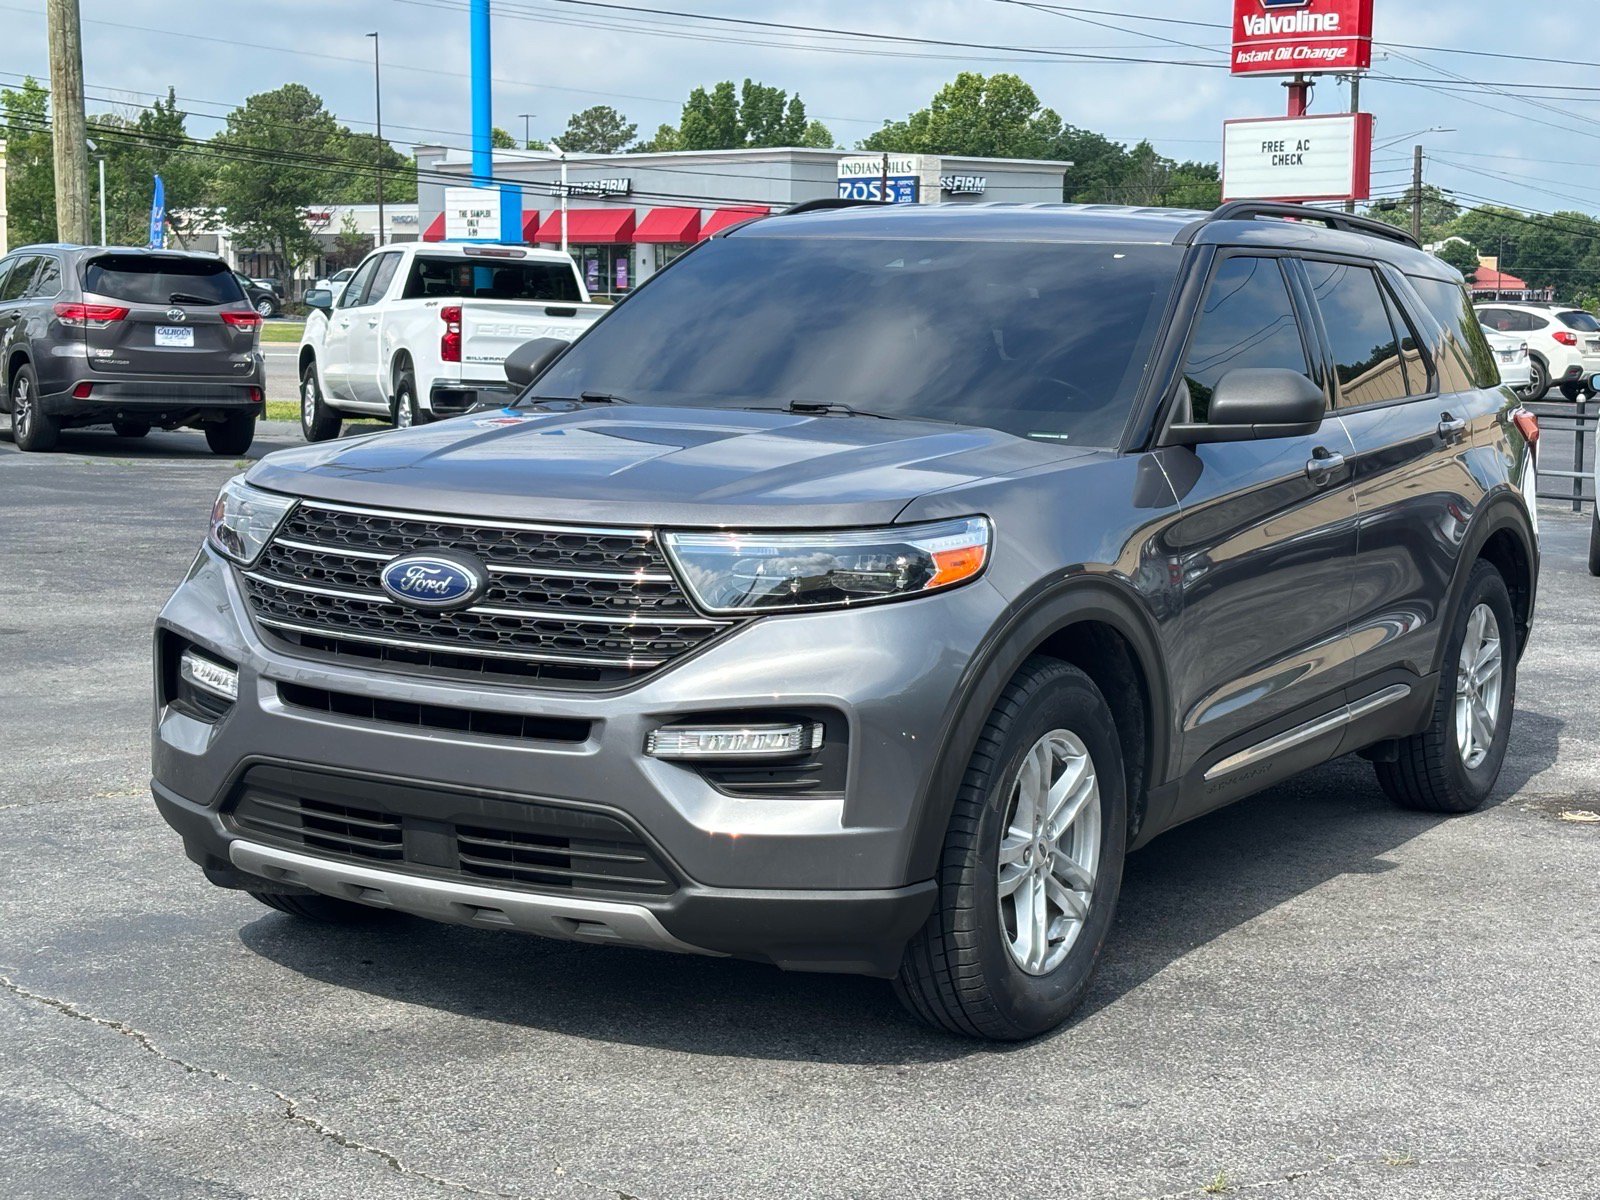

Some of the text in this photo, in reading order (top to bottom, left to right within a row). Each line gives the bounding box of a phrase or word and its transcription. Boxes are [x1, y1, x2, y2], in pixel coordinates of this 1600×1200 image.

[1242, 10, 1340, 36] Valvoline
[1235, 46, 1348, 64] Instant Oil Change
[1261, 139, 1310, 153] FREE AC
[1271, 153, 1304, 166] CHECK
[841, 161, 881, 175] INDIAN
[458, 209, 468, 218] THE
[467, 219, 480, 227] ONLY
[157, 327, 191, 337] CALHOUN
[400, 565, 453, 595] Ford
